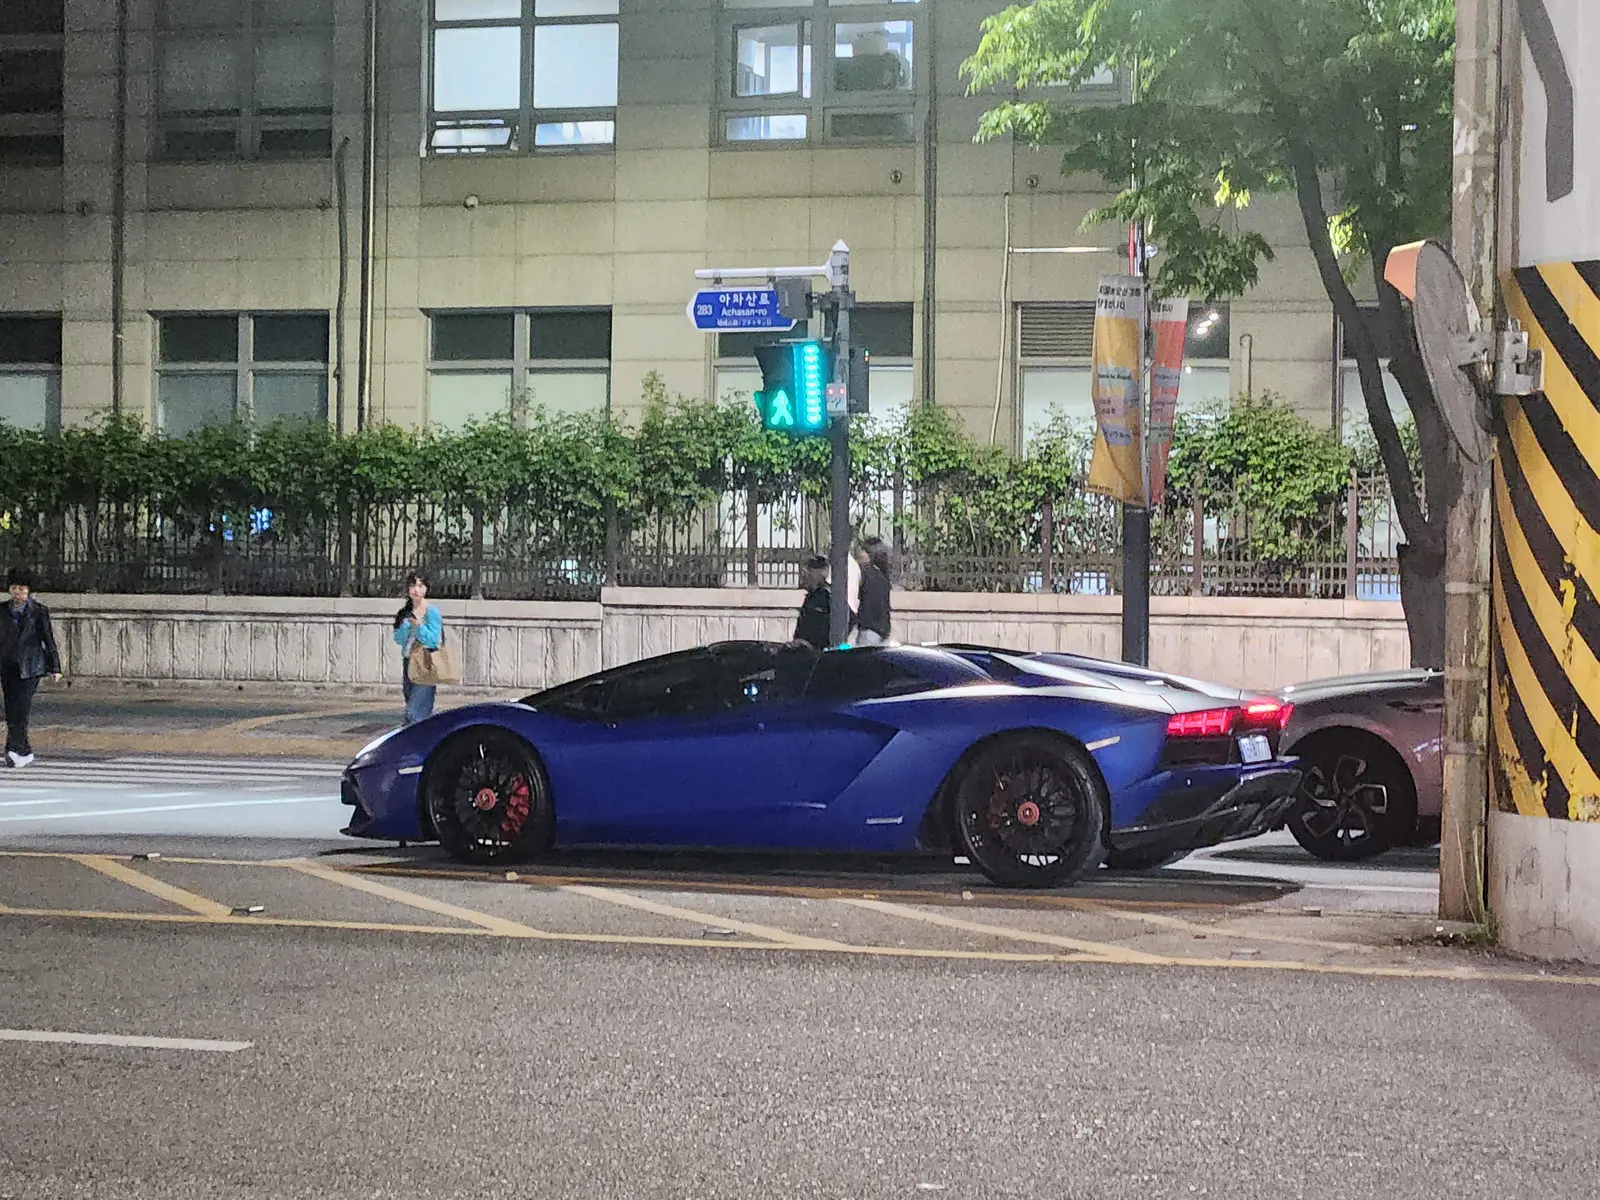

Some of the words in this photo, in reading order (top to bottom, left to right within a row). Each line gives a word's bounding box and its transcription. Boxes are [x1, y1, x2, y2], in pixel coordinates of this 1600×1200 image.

[719, 292, 770, 307] 아차산로
[697, 304, 713, 316] 283
[721, 307, 768, 317] Achasan-ro
